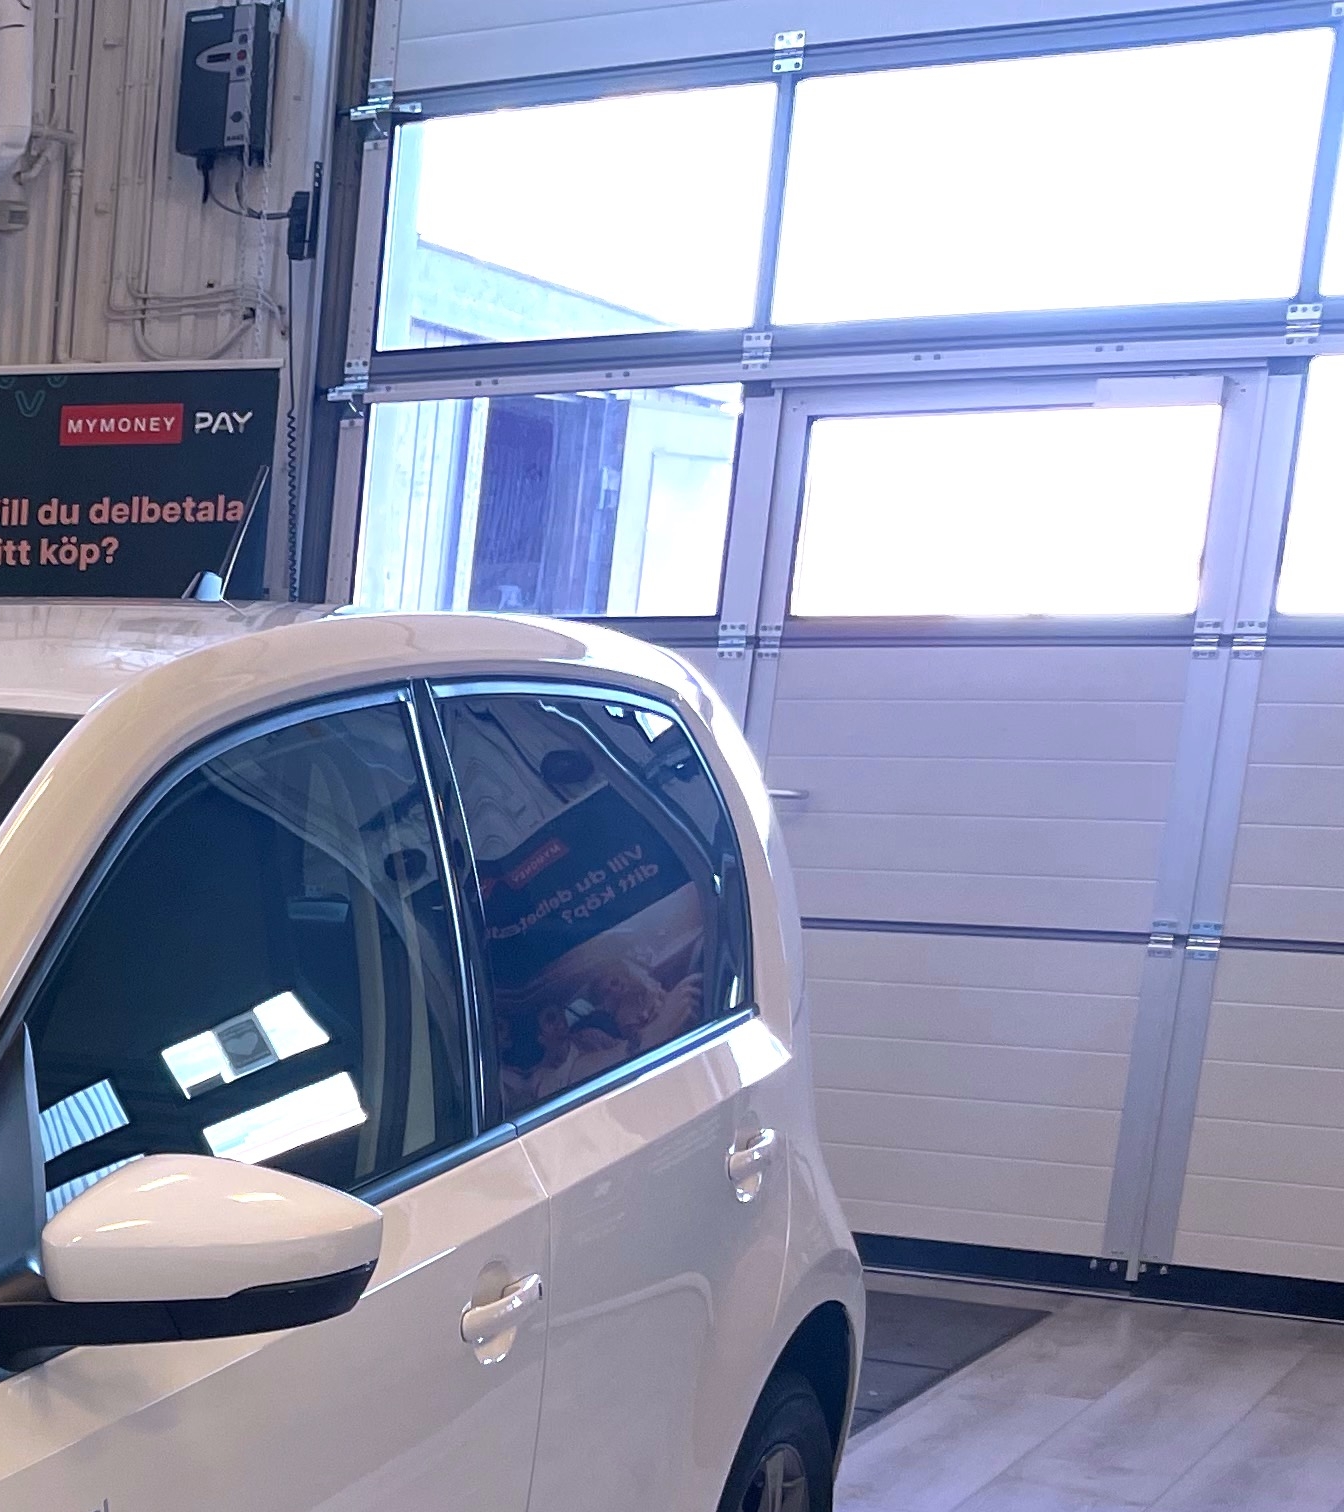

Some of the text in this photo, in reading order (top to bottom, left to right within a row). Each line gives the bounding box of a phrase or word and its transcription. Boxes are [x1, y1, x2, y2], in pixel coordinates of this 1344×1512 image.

[66, 411, 253, 434] MYMONEY PAY
[37, 497, 80, 526] du
[88, 494, 245, 524] delbetala
[39, 536, 120, 571] köp?
